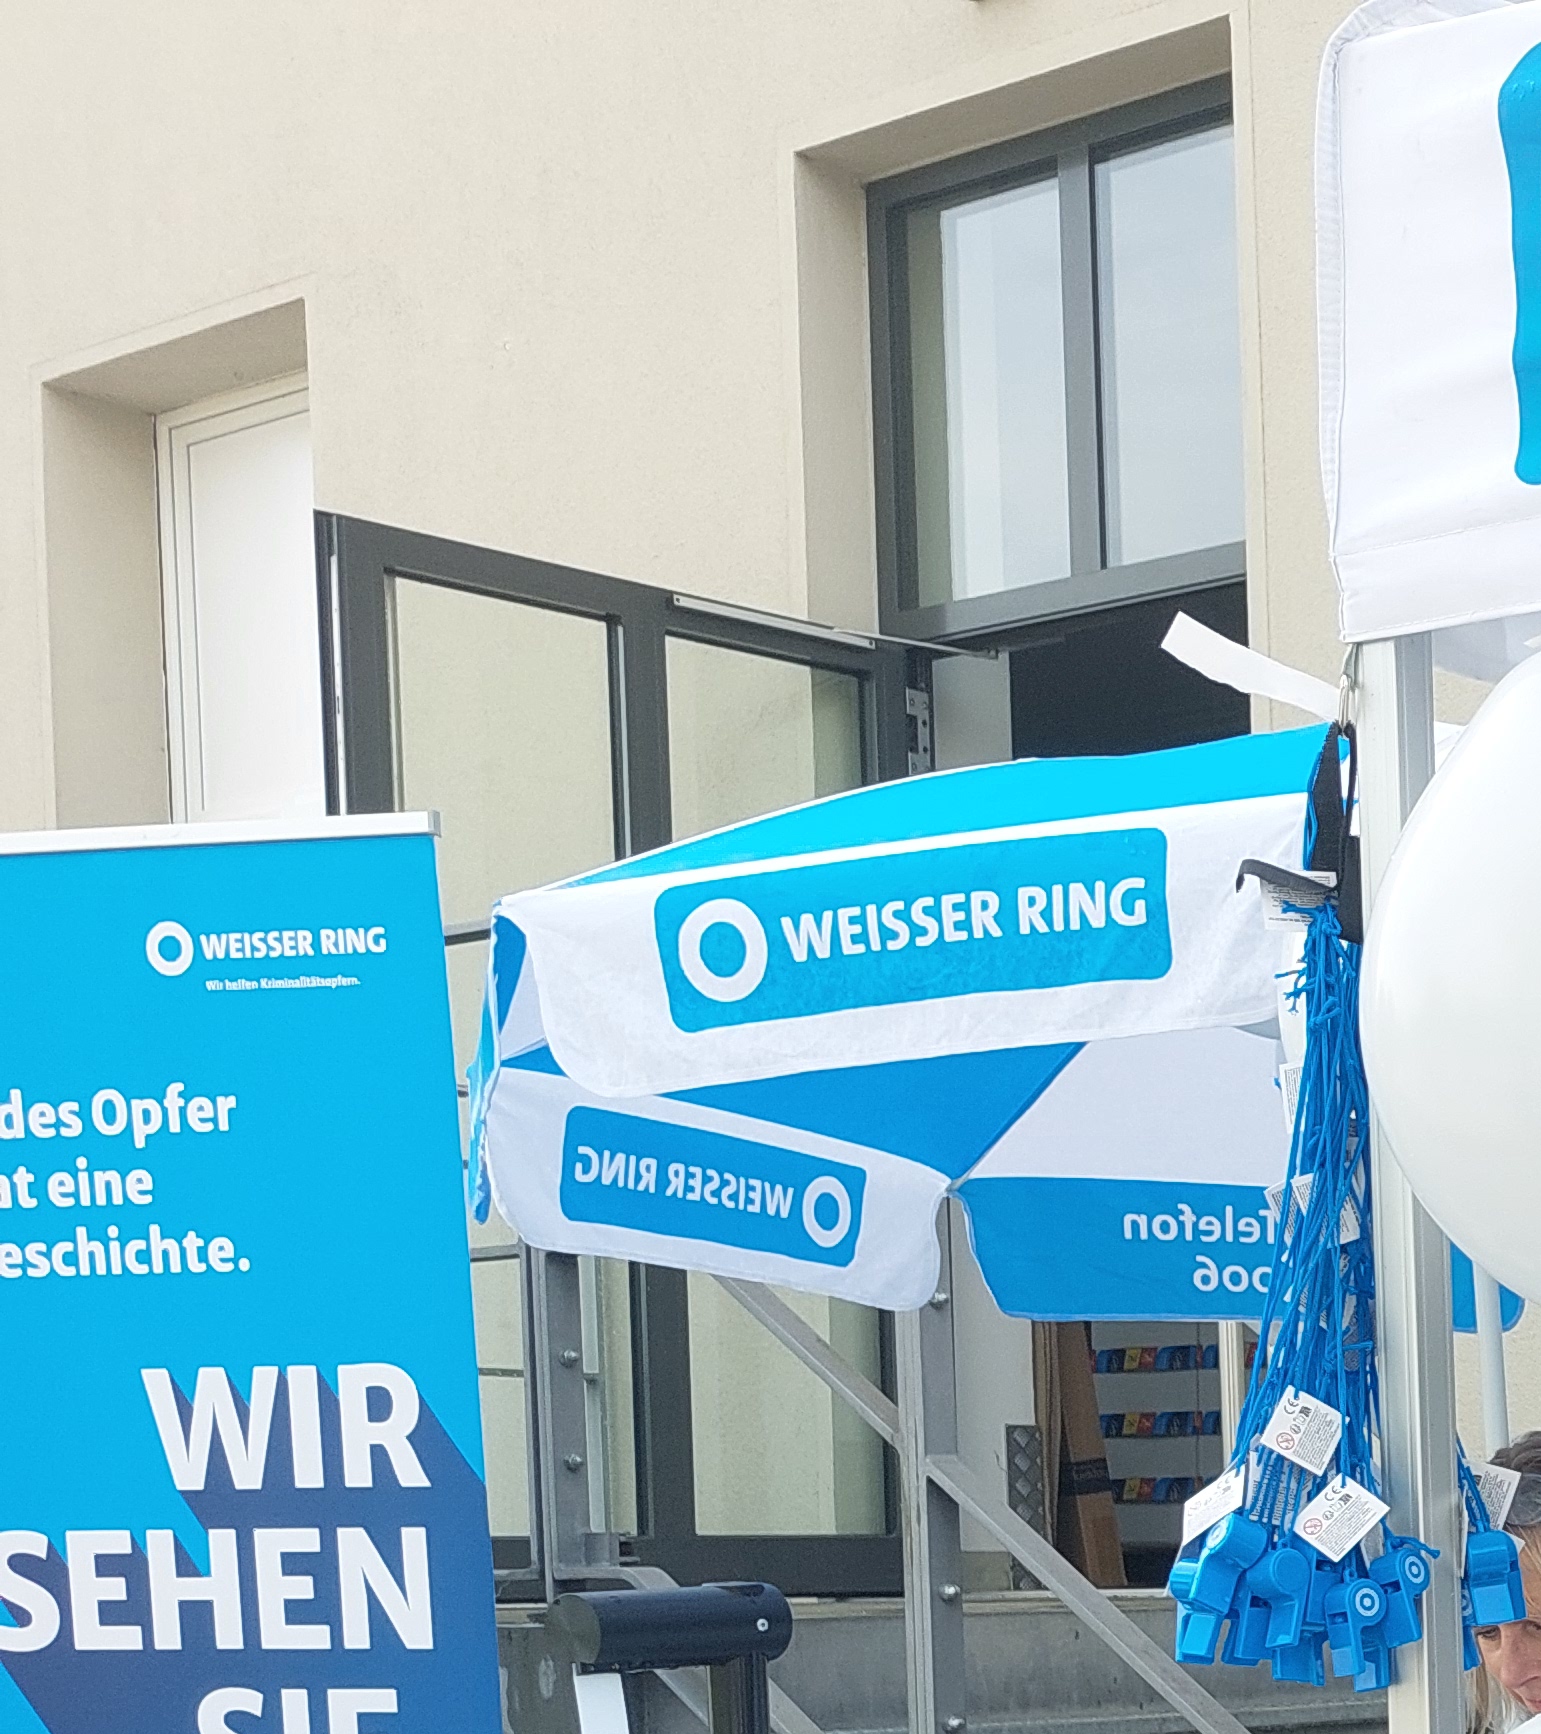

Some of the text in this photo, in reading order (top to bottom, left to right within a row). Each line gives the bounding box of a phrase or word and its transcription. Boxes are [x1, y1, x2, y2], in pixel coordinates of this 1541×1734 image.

[199, 926, 387, 961] WEISSER RING
[781, 877, 1147, 963] WEISSER RING
[205, 979, 224, 991] Wir
[92, 1081, 238, 1148] Opfer
[47, 1157, 153, 1206] eine
[140, 1362, 432, 1491] WIR
[0, 1527, 434, 1652] SEHEN
